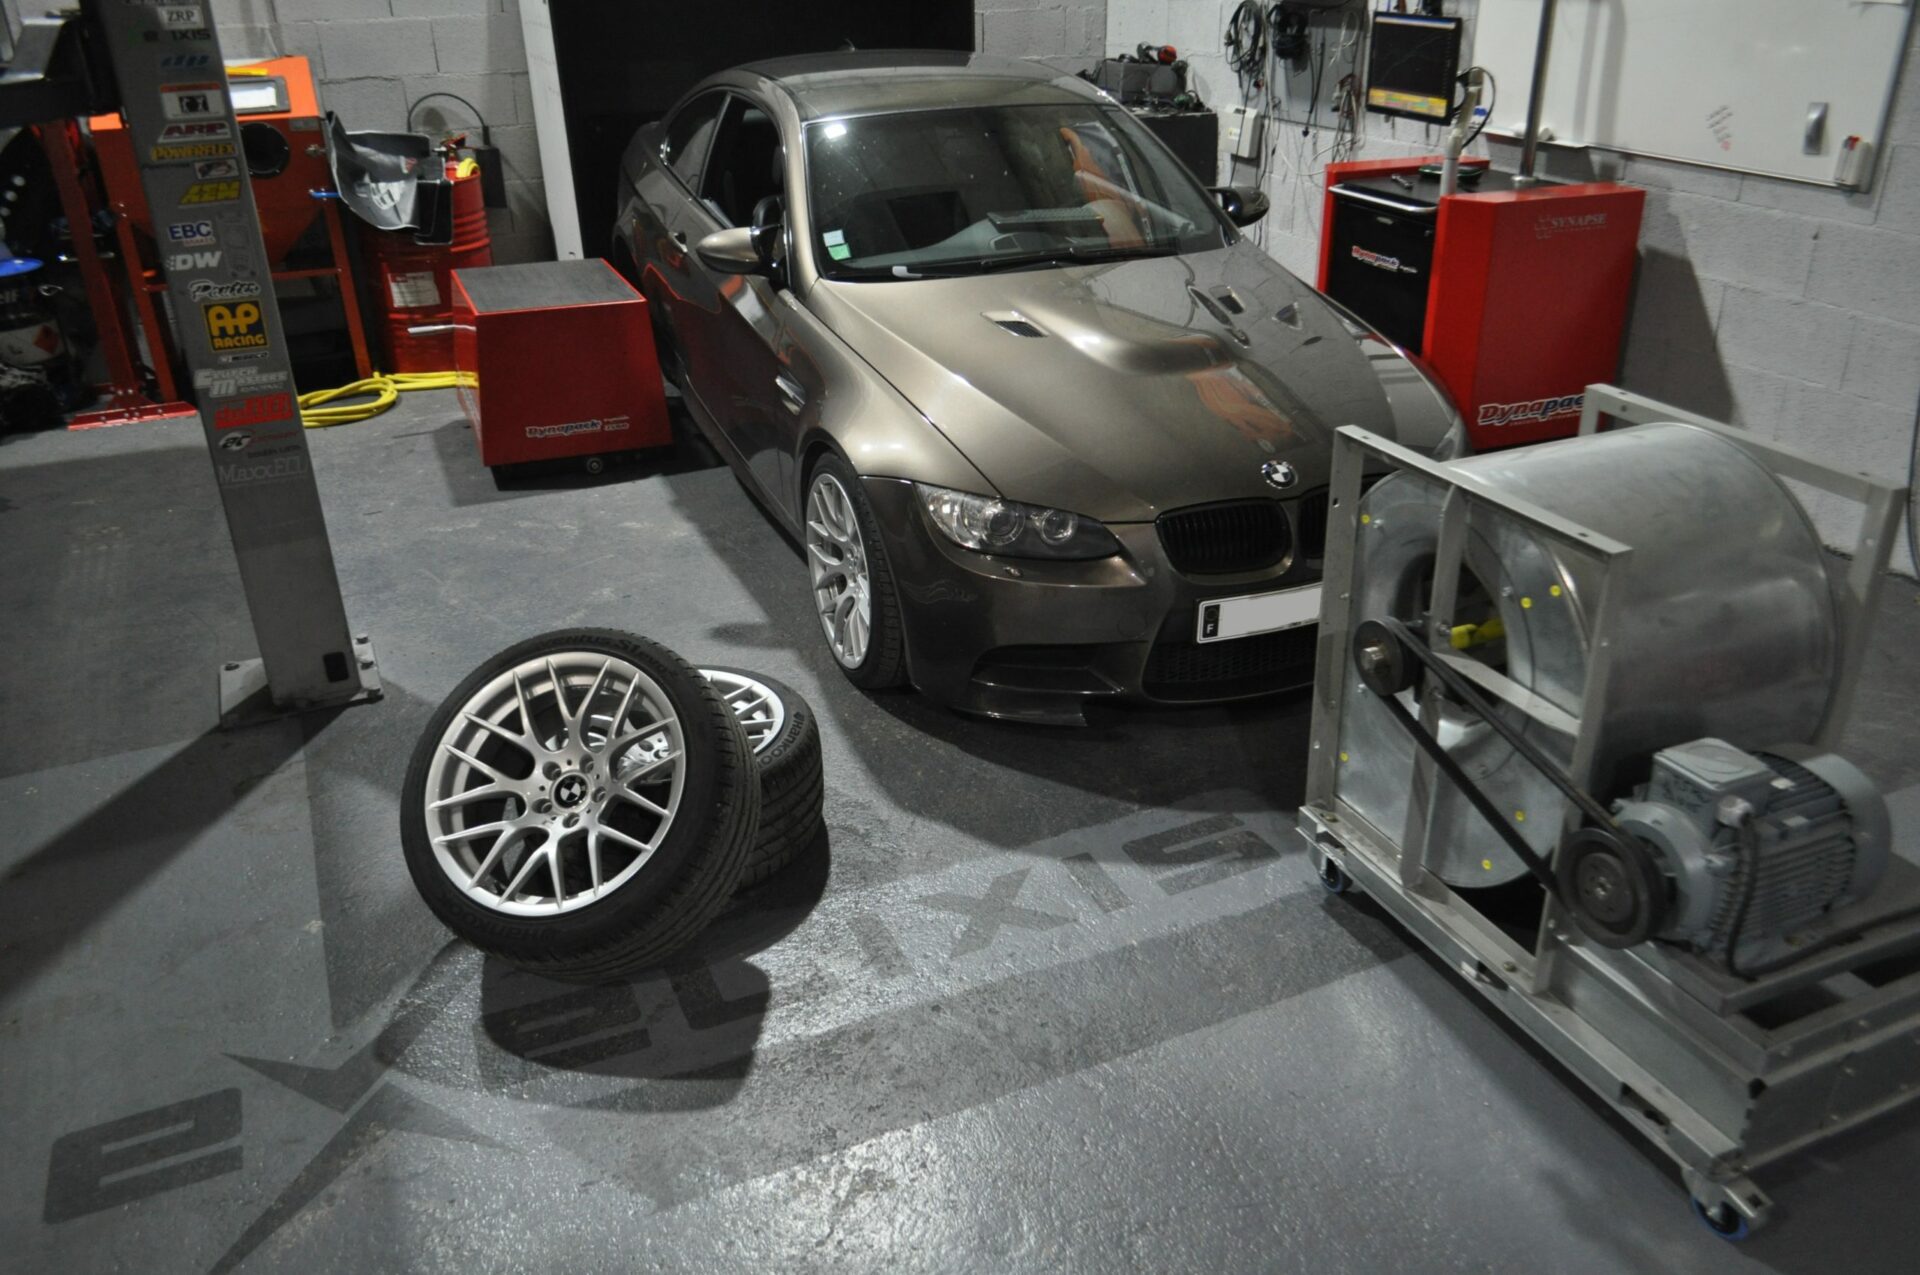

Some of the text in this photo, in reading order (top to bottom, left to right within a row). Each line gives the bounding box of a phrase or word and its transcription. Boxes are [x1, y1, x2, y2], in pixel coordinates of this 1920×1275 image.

[167, 9, 196, 23] ZRP
[1552, 213, 1608, 228] SYNAPSE
[169, 222, 212, 241] EBC
[176, 251, 222, 271] DW
[213, 334, 266, 349] RACING
[1477, 394, 1585, 427] Dynapac
[525, 419, 603, 438] Dynapack
[1206, 623, 1215, 635] F
[758, 719, 805, 769] Hankoo
